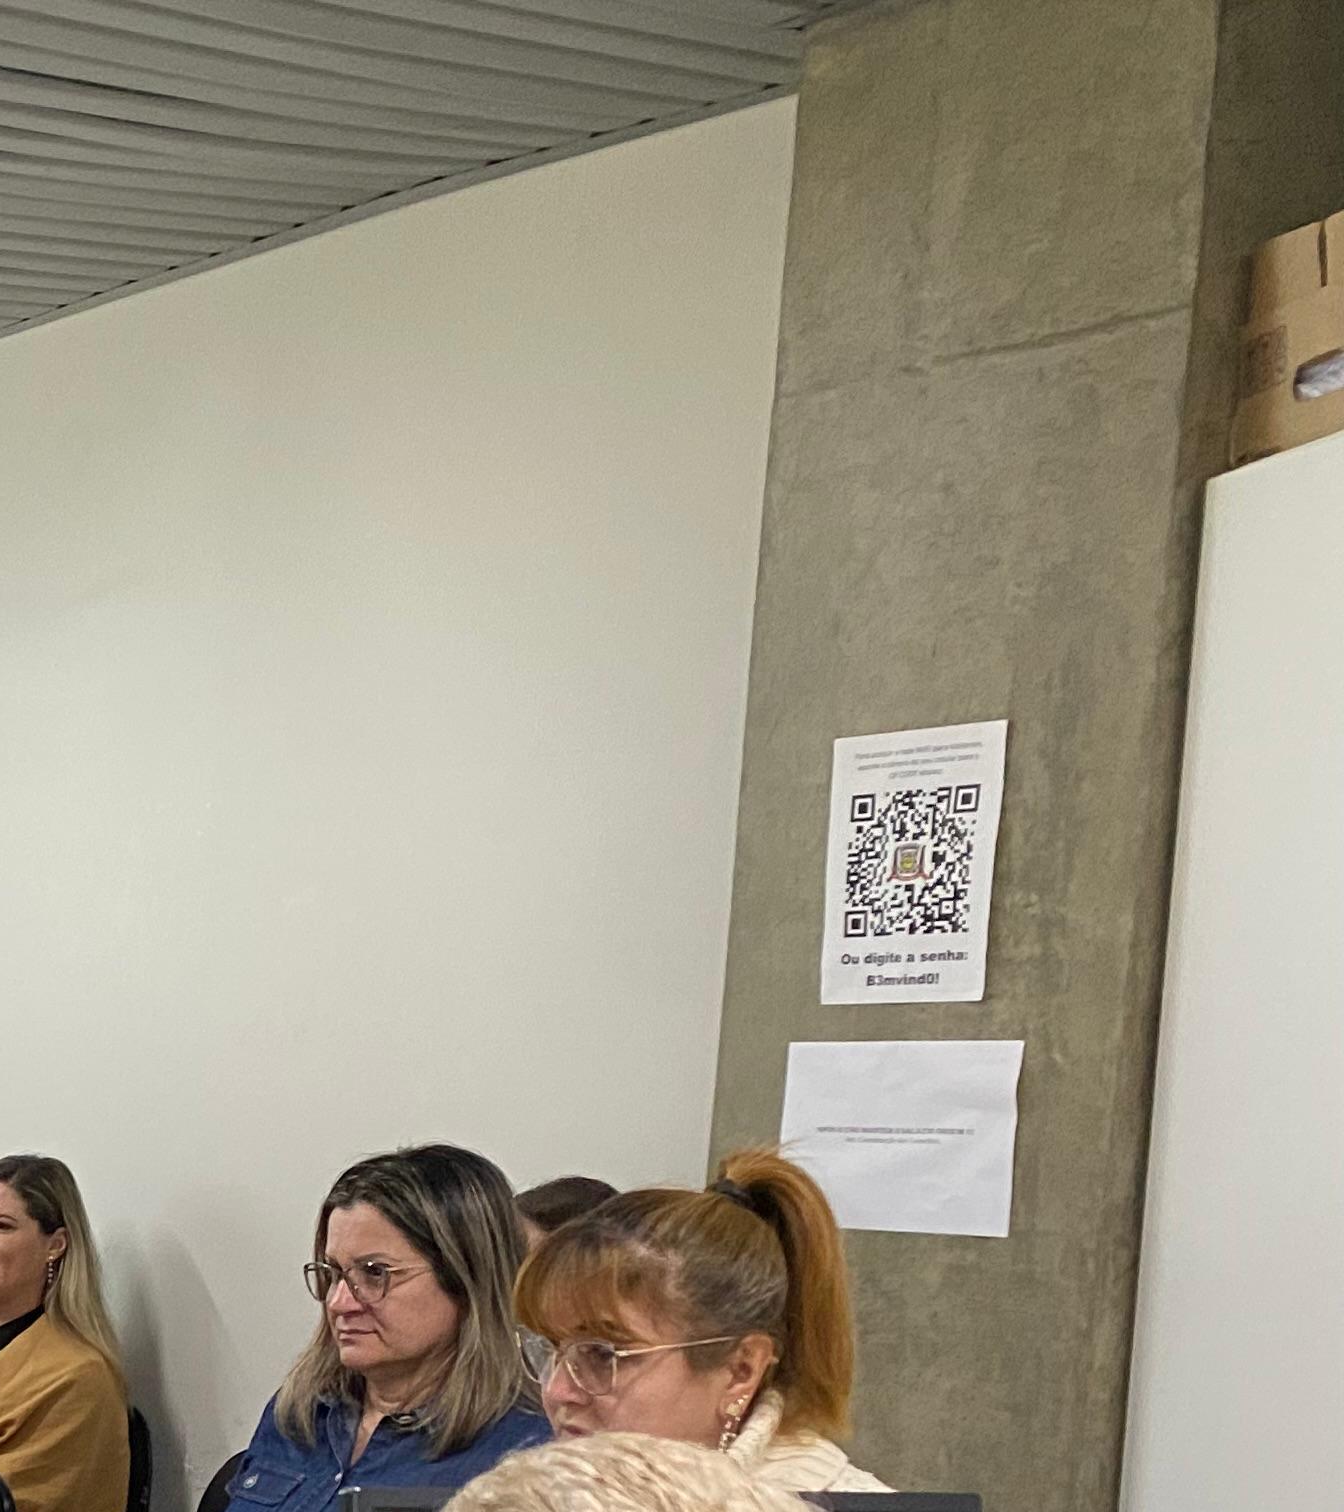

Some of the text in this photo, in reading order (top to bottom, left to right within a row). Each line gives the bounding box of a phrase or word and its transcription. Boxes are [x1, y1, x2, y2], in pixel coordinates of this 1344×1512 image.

[840, 950, 969, 967] Ou digite a senha:
